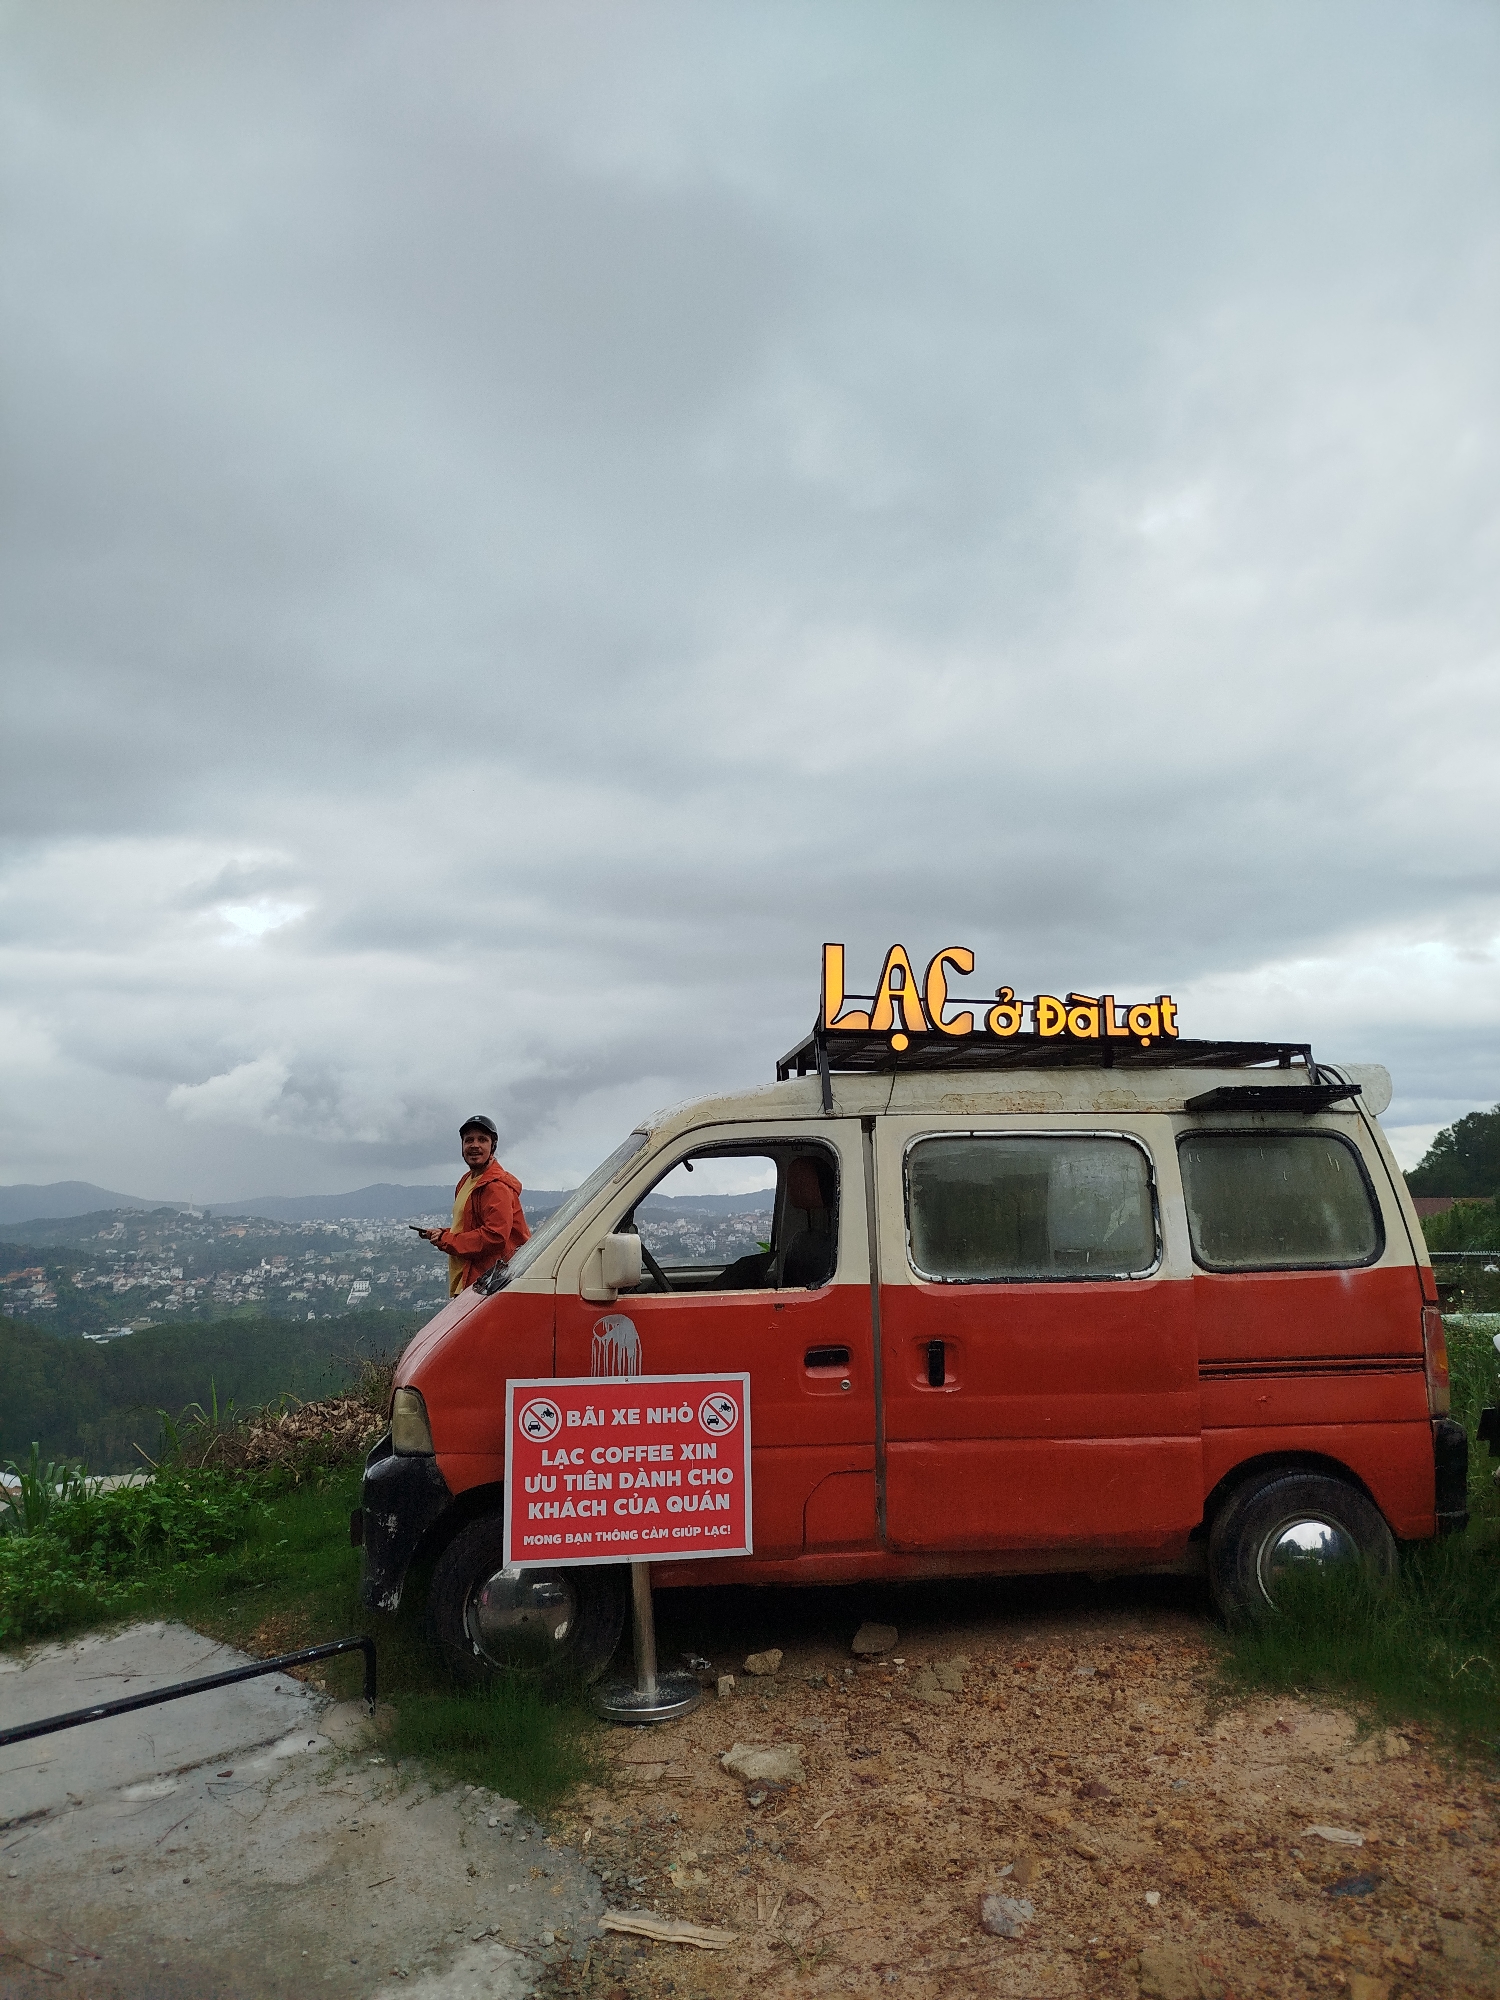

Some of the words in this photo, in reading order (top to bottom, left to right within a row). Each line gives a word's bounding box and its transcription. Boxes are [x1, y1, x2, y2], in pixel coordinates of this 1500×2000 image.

[821, 943, 974, 1051] LẠC
[984, 986, 1023, 1036] ở
[566, 1405, 605, 1427] BÃI
[611, 1408, 640, 1426] XE
[646, 1402, 694, 1424] NHỎ
[541, 1448, 585, 1470] LẠC
[590, 1444, 674, 1464] COFFEE
[679, 1443, 717, 1461] XIN
[524, 1473, 557, 1493] ƯU
[563, 1470, 612, 1491] TIÊN
[619, 1468, 682, 1489] DÀNH
[687, 1467, 733, 1485] CHO
[528, 1497, 607, 1519] KHÁCH
[613, 1493, 660, 1516] CỦA
[666, 1490, 731, 1512] QUÁN
[523, 1535, 562, 1546] MONG
[565, 1532, 592, 1546] BẠN
[595, 1528, 638, 1542] THÔNG
[672, 1524, 701, 1537] GIÚP
[704, 1524, 731, 1539] LẠC!
